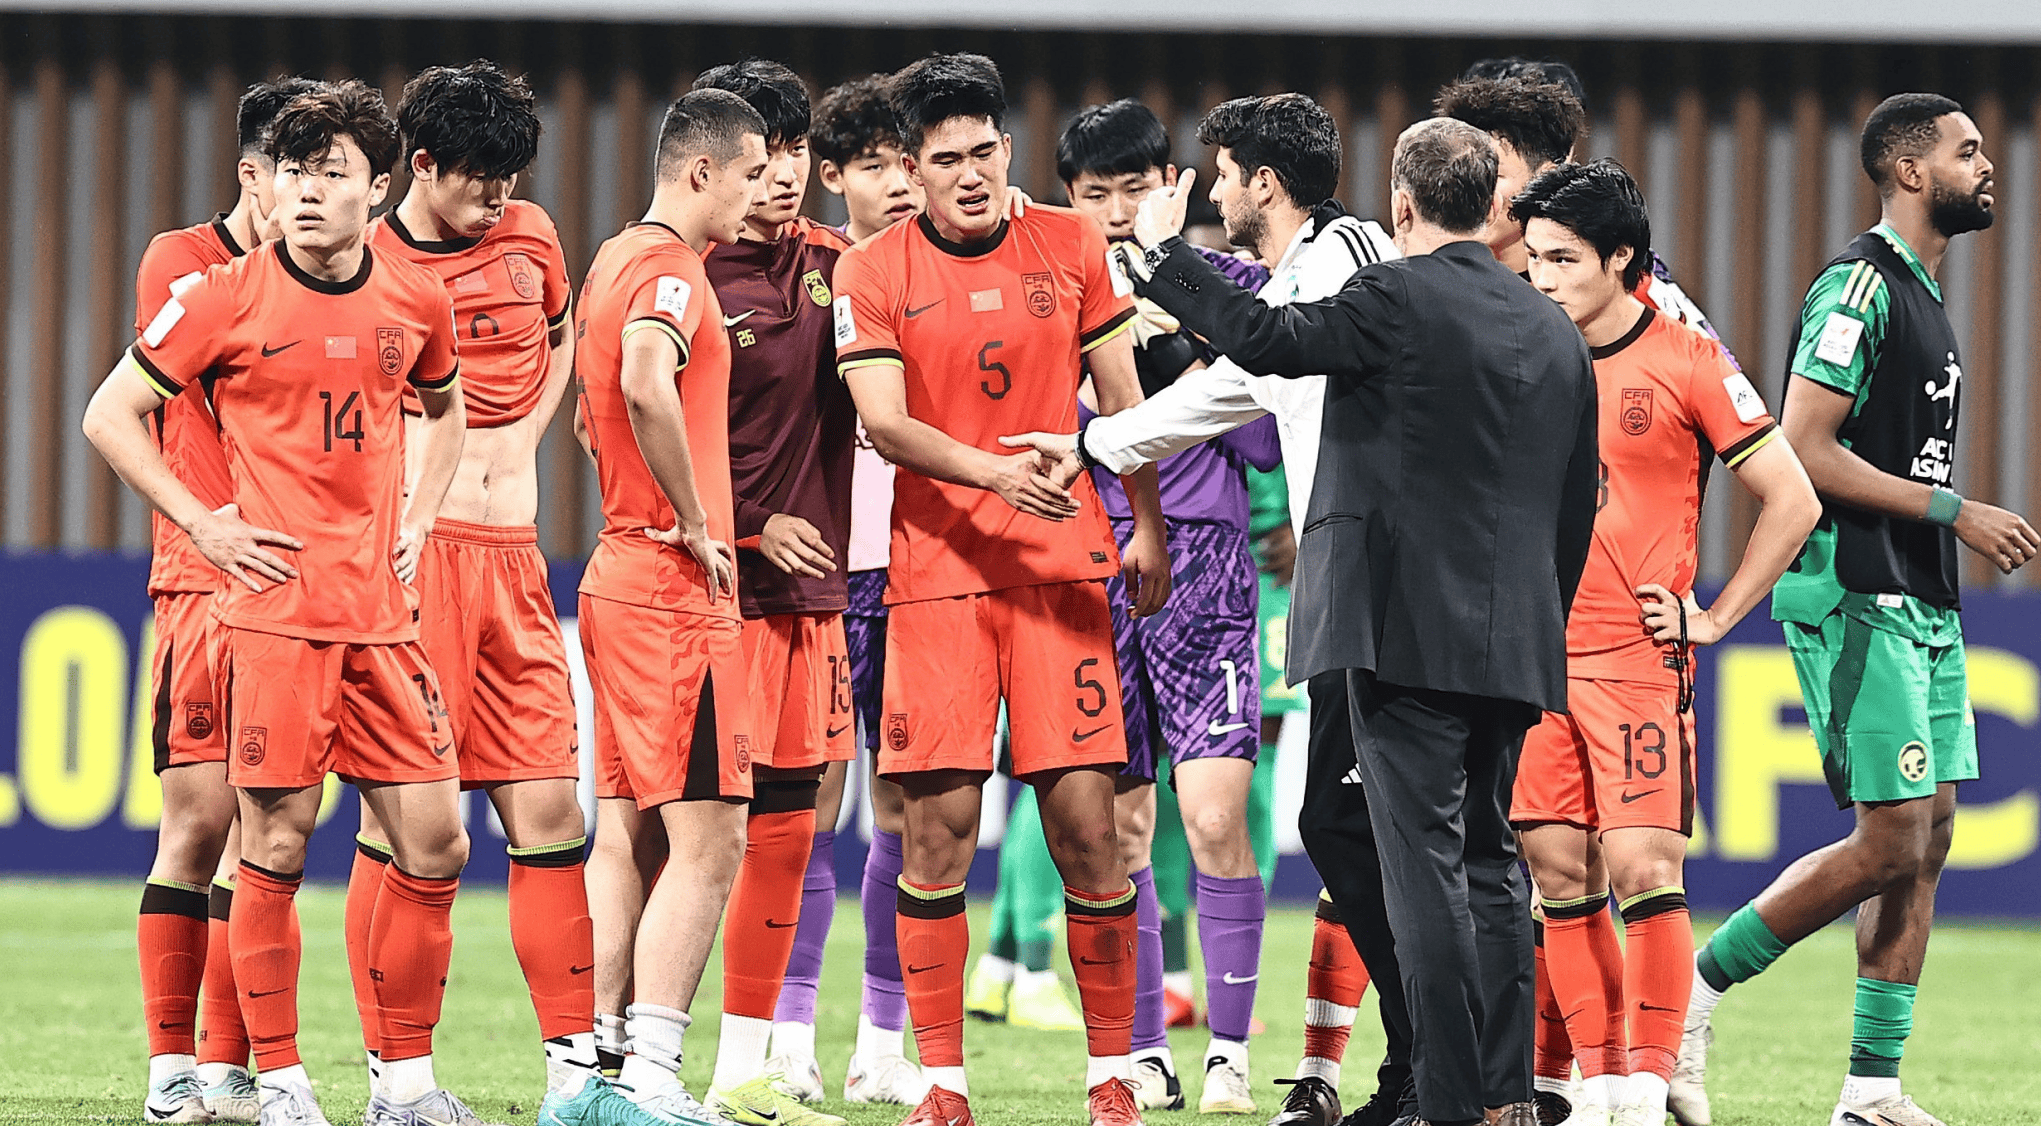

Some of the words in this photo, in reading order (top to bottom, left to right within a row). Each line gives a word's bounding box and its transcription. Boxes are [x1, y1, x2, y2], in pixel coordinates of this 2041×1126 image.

[1025, 274, 1050, 285] CFA
[379, 330, 401, 339] CFA
[736, 328, 757, 348] 26
[978, 340, 1012, 400] 5
[1624, 391, 1650, 400] CFA
[319, 391, 364, 452] 14
[827, 654, 851, 714] 15
[1074, 658, 1107, 717] 5
[1220, 660, 1238, 714] 1
[244, 728, 265, 736] CFA
[1618, 722, 1666, 779] 13
[1687, 645, 2040, 868] FC
